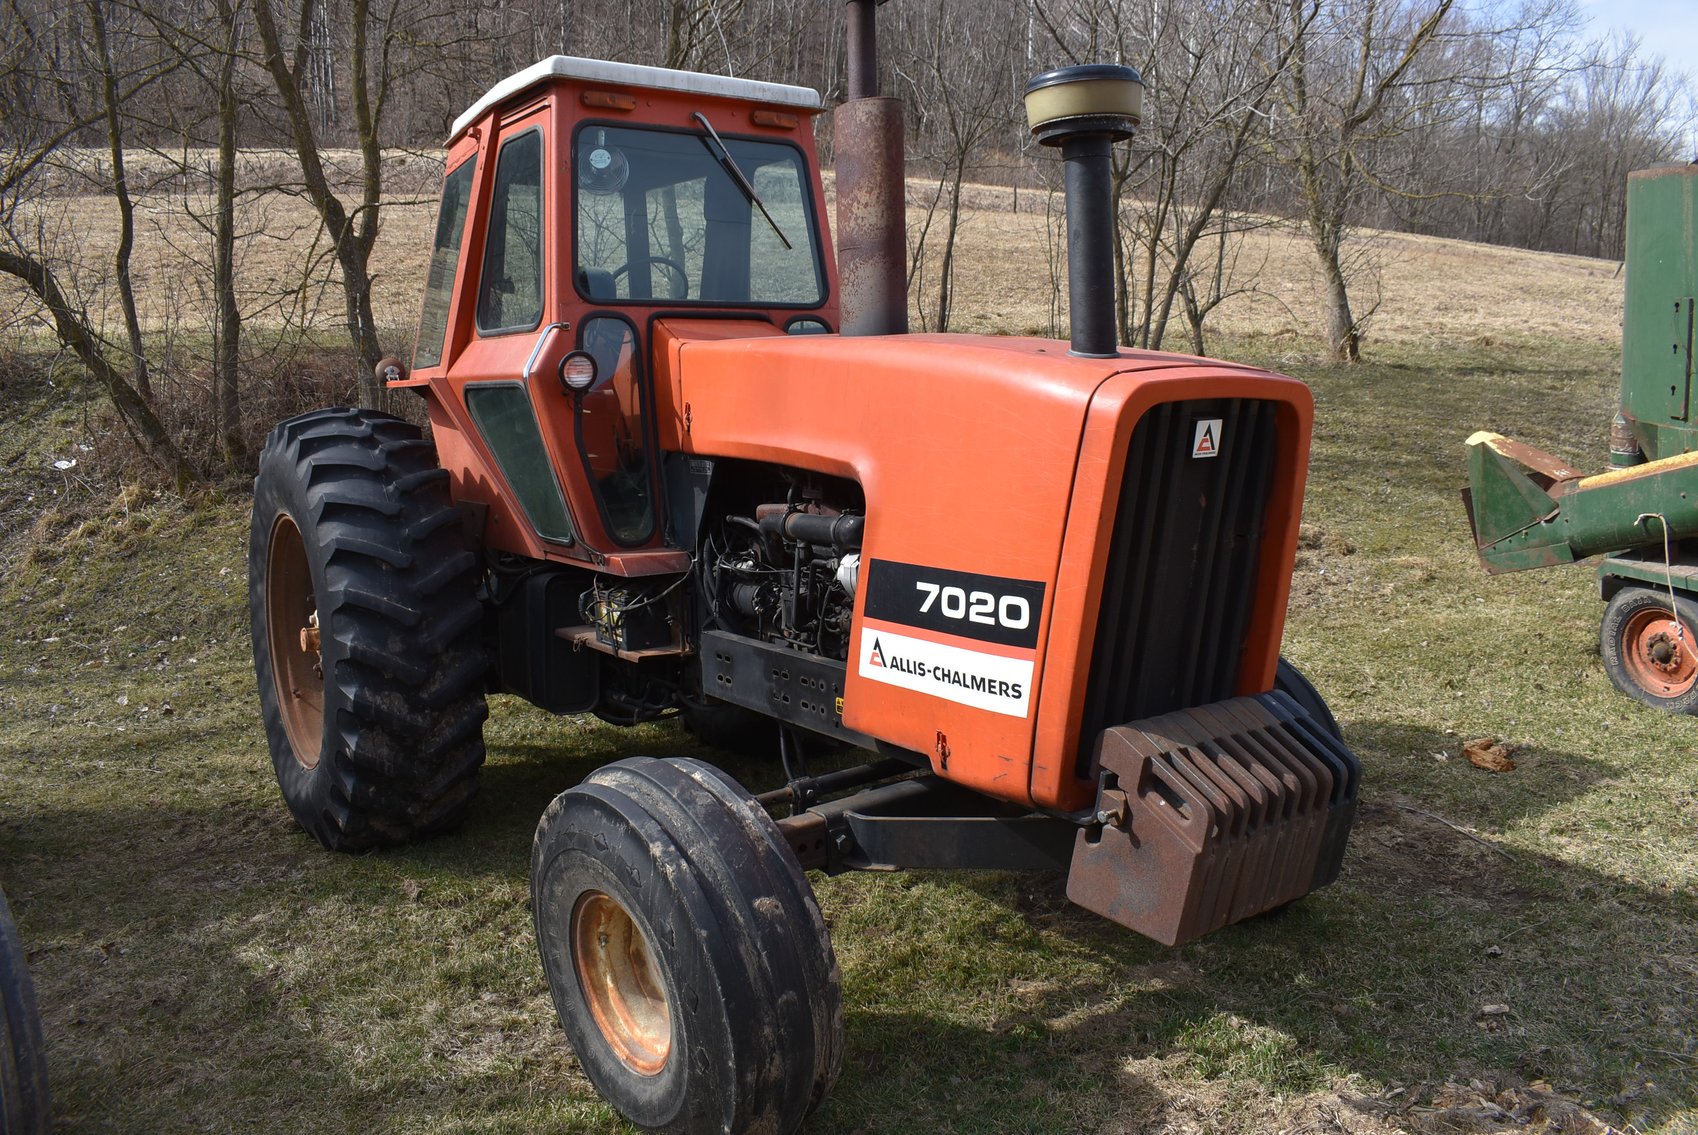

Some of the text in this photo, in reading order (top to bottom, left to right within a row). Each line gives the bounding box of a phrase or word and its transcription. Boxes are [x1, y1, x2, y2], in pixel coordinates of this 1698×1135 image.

[916, 581, 1030, 630] 7020
[1608, 596, 1652, 666] RADIAL BAJA
[889, 655, 1023, 700] ALLIS-CHALMERS
